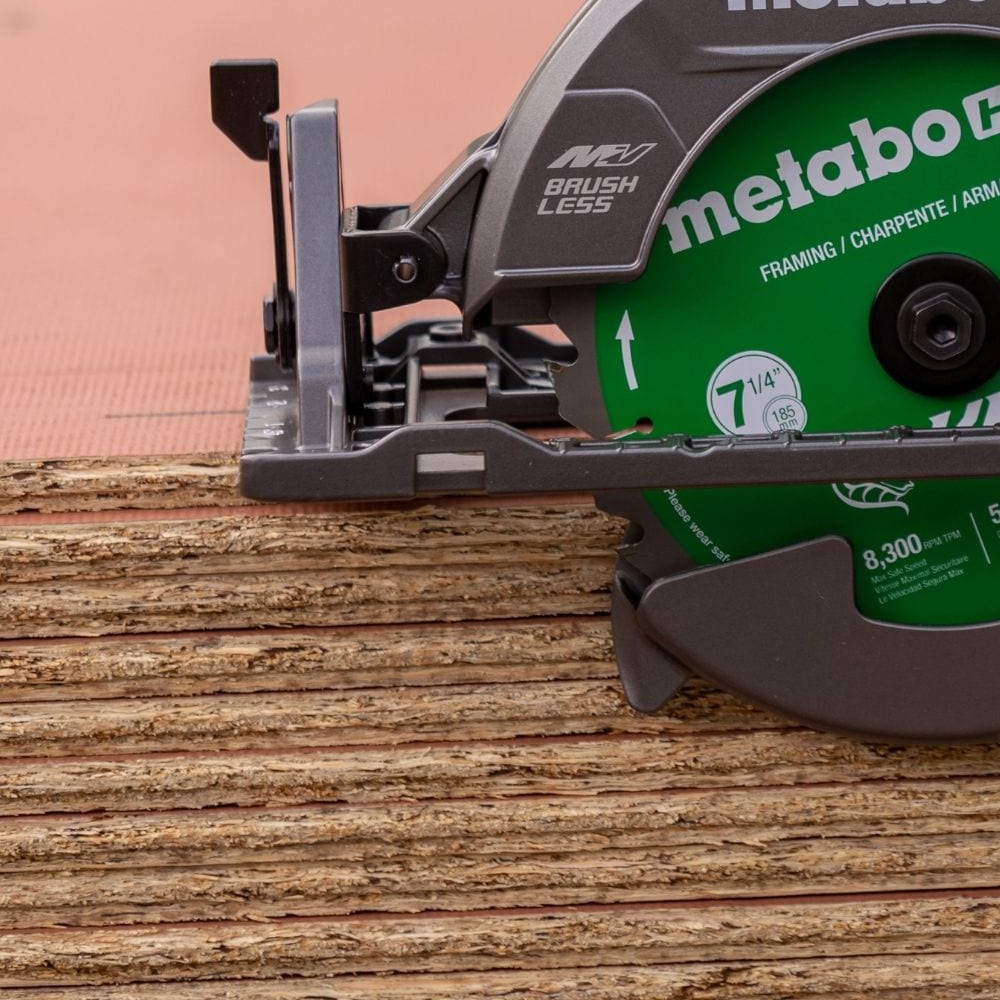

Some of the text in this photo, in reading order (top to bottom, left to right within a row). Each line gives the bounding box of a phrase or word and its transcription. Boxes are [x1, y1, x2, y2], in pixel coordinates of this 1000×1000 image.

[544, 176, 639, 196] BRUSH
[662, 109, 962, 254] metabo
[537, 196, 614, 215] LESS
[759, 241, 837, 282] FRAMING
[850, 199, 949, 249] CHARPENTE
[716, 378, 746, 429] 7
[772, 404, 796, 423] 185
[779, 418, 798, 431] mm
[663, 488, 731, 563] Please wear saf
[862, 533, 923, 570] 8,300
